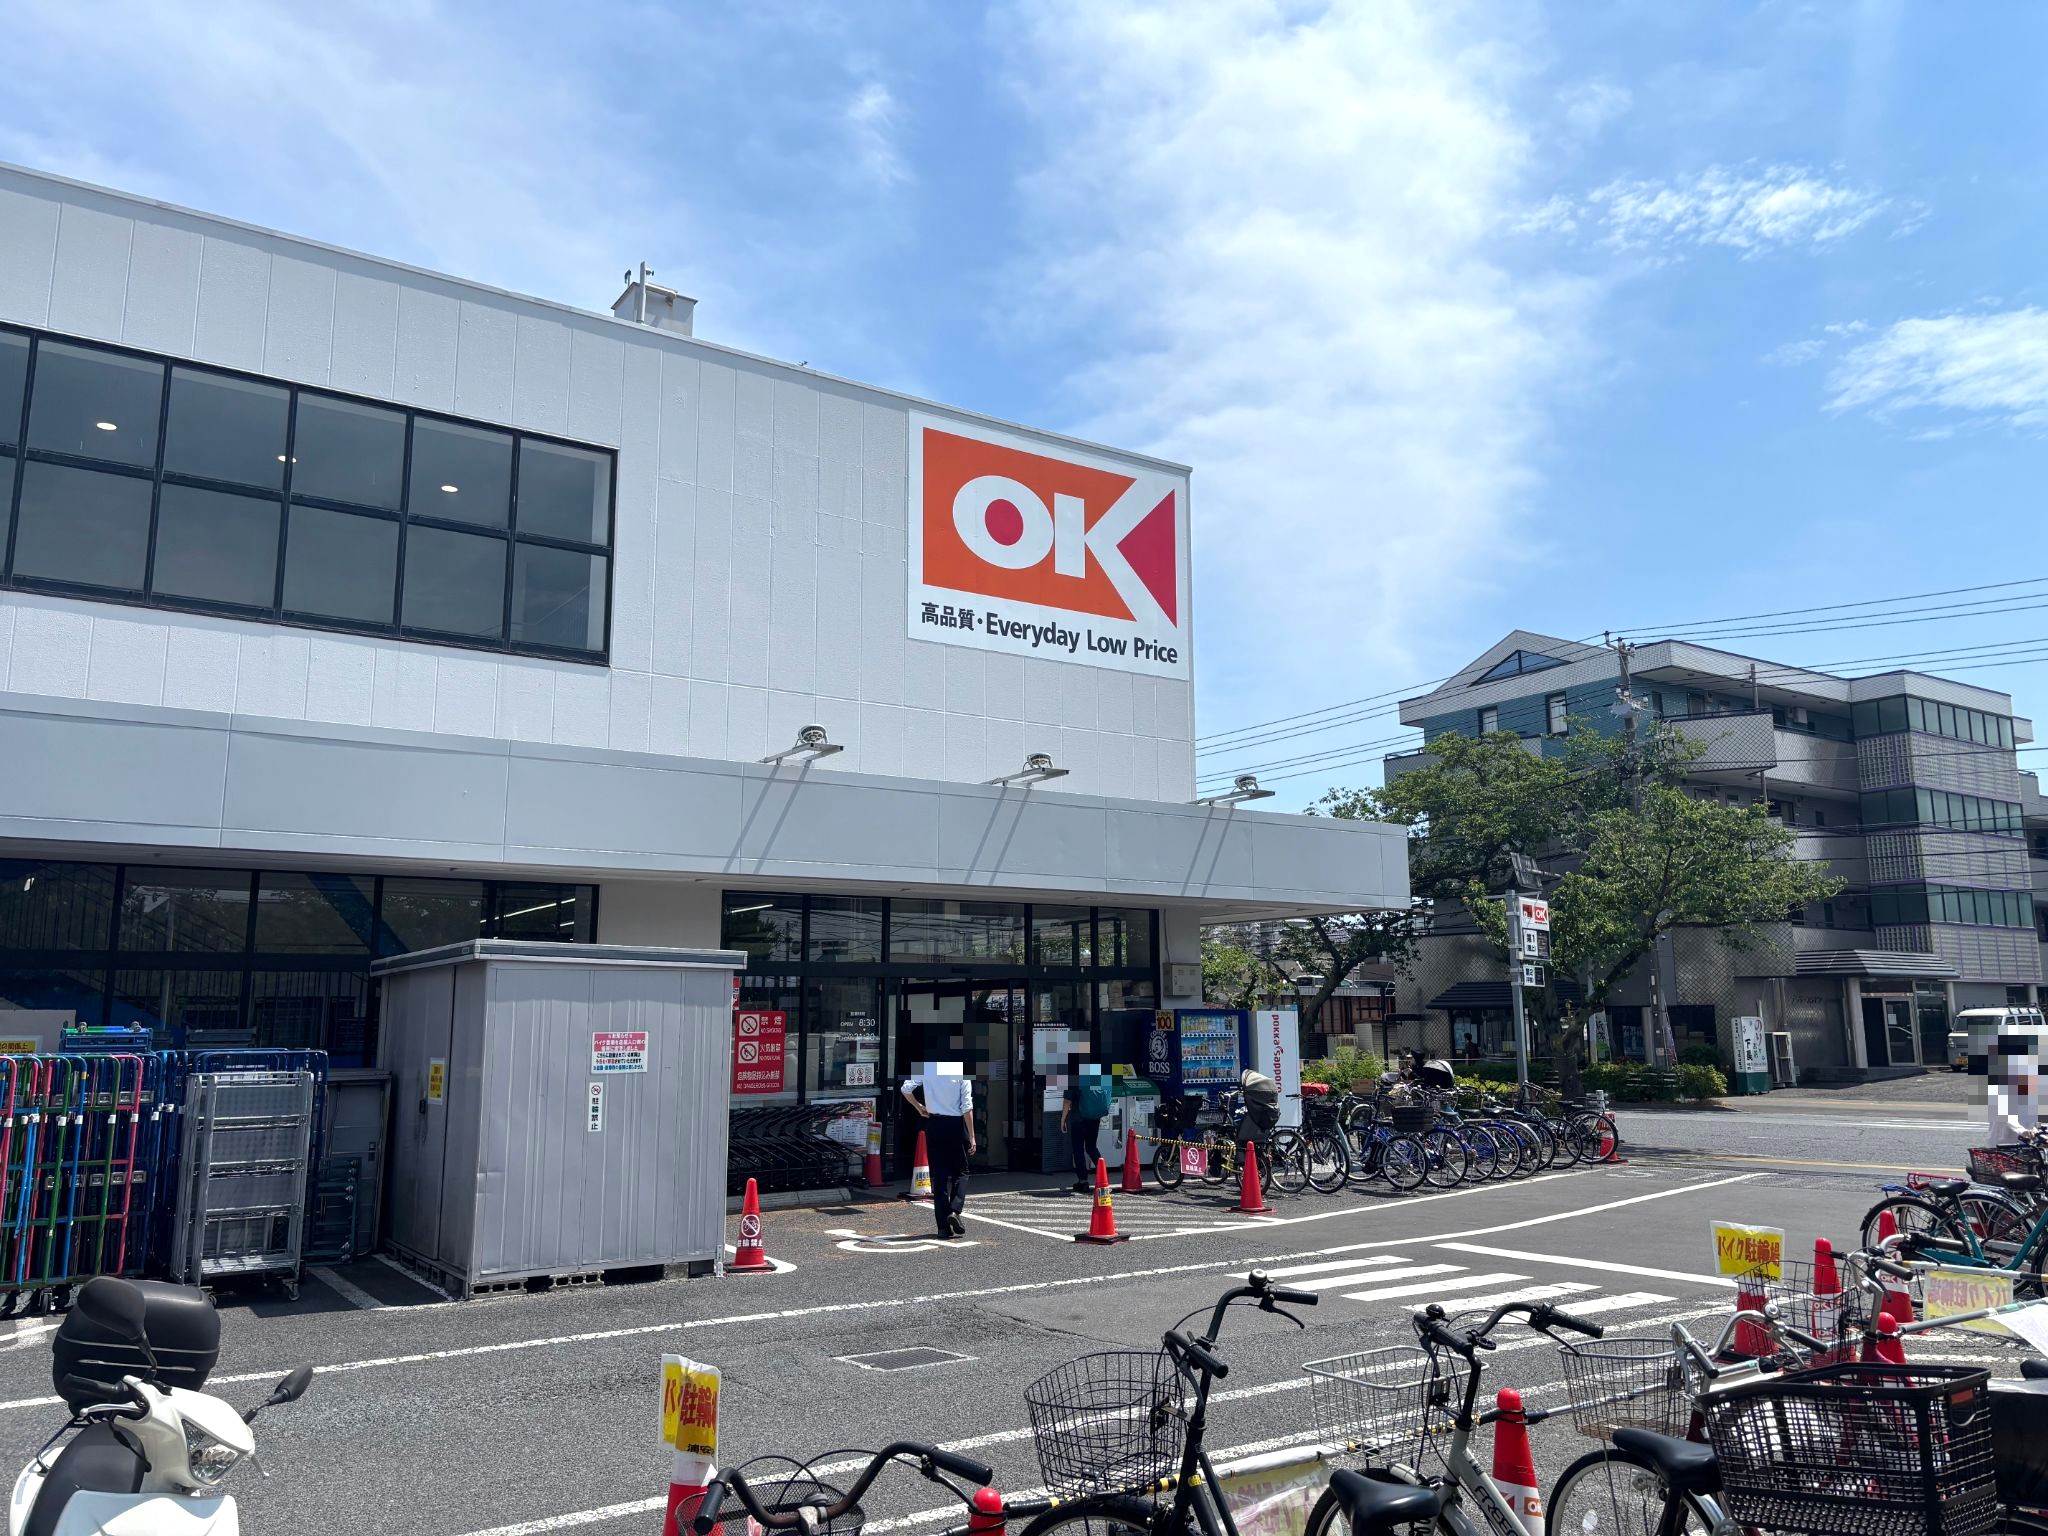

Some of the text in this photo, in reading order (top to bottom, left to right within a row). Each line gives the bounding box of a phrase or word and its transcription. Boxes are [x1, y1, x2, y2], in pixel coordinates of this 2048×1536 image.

[952, 475, 1176, 629] OK
[1086, 629, 1127, 656] Low
[1134, 637, 1178, 664] Price
[858, 1018, 876, 1027] 8:30
[1149, 1061, 1170, 1073] BOSS
